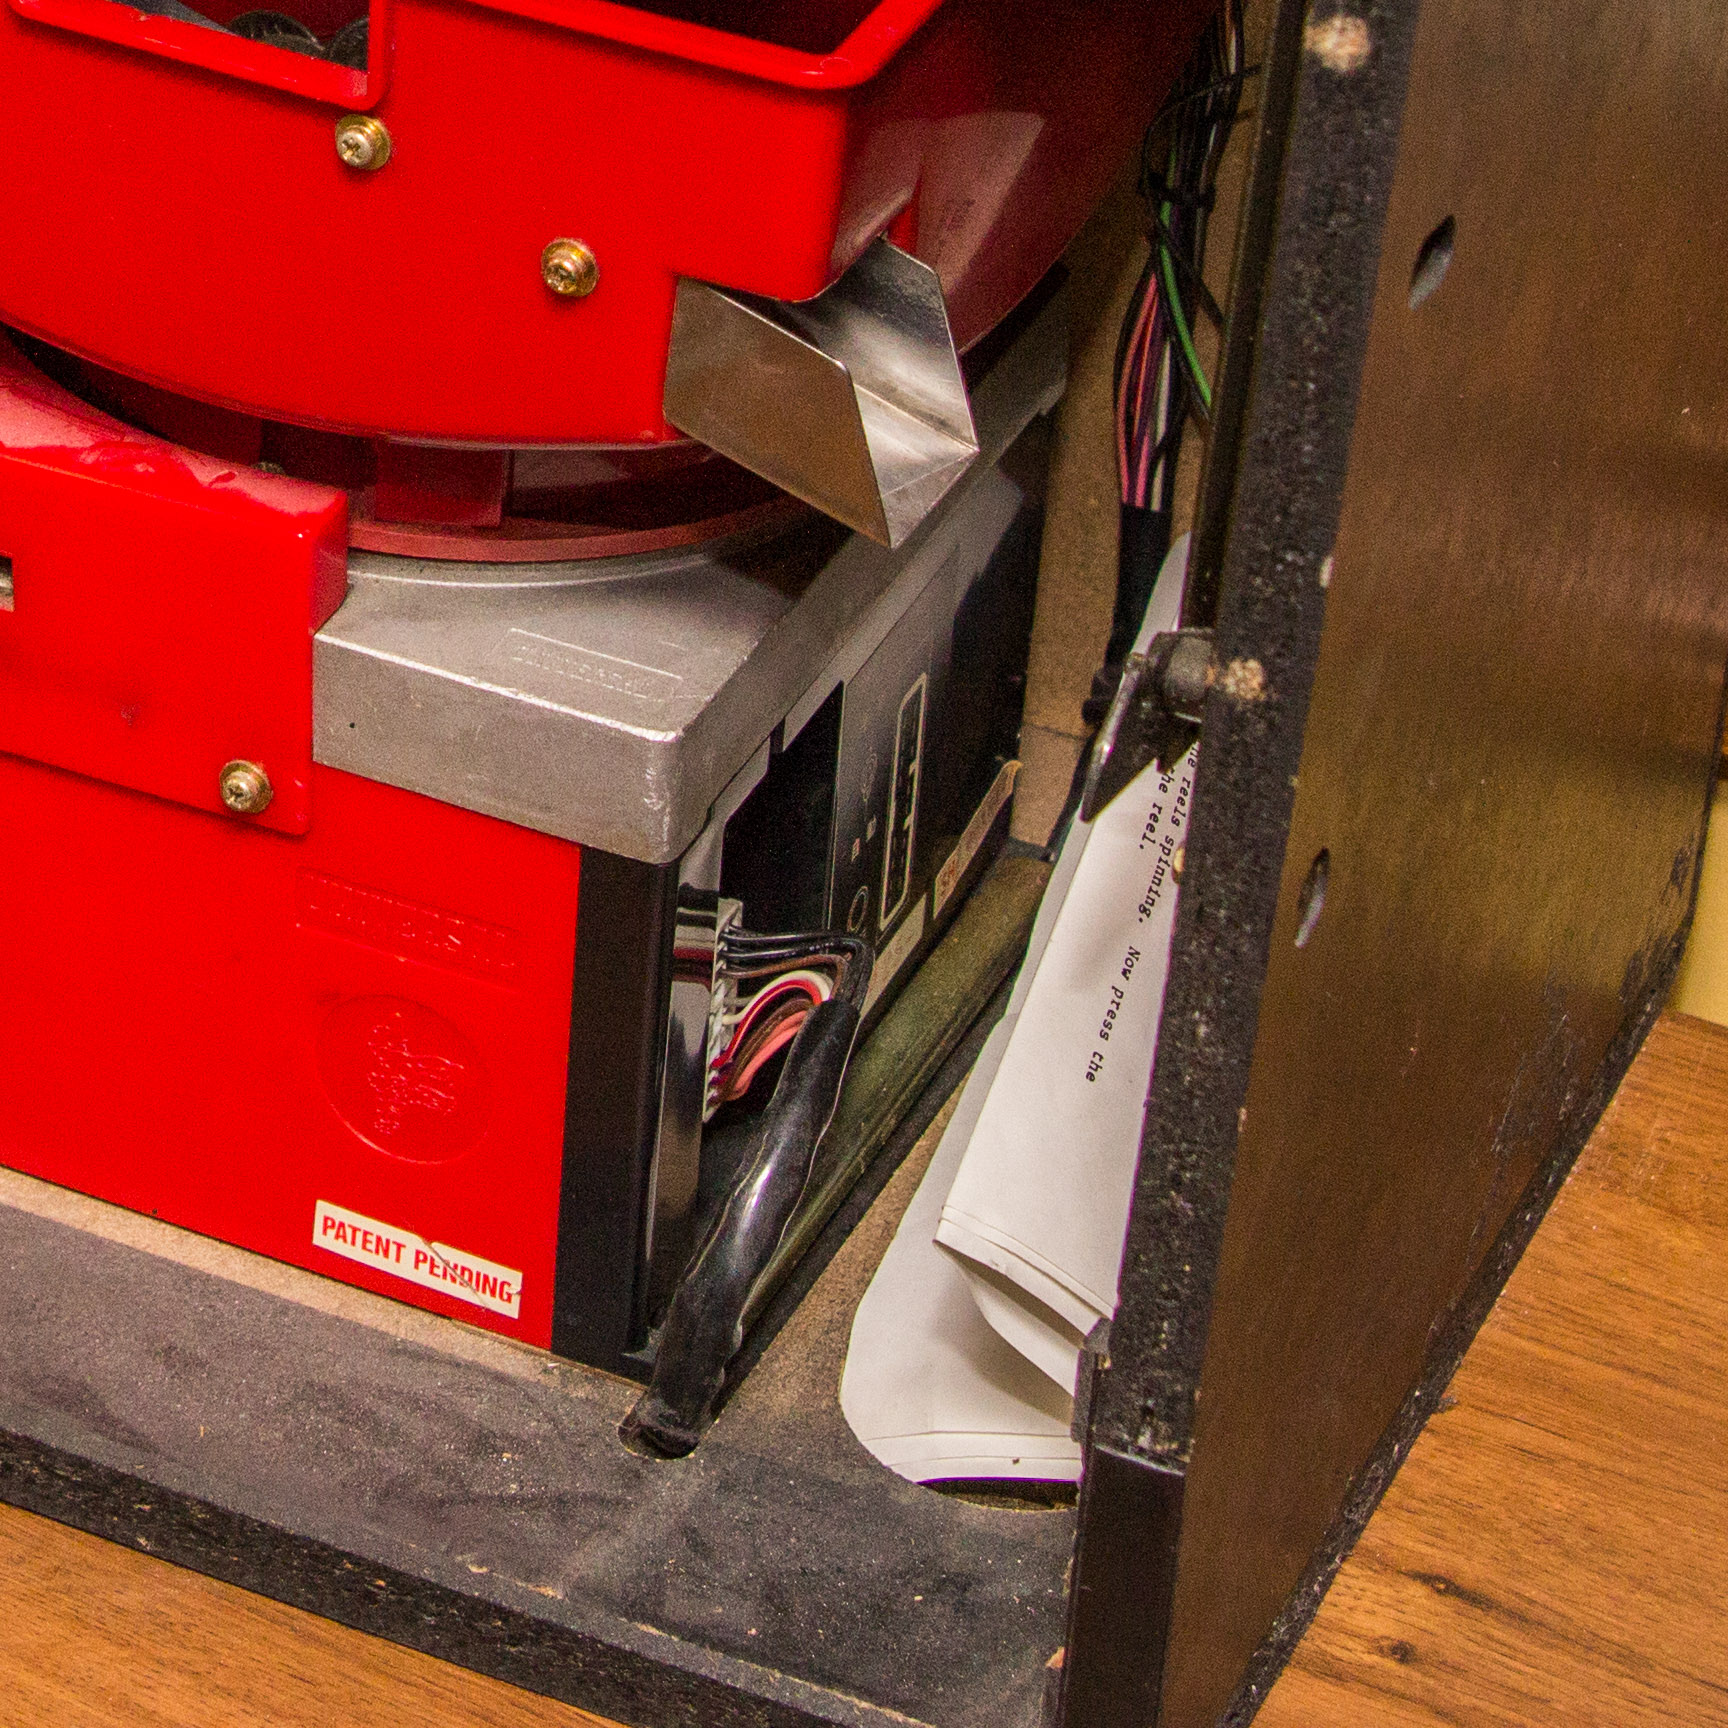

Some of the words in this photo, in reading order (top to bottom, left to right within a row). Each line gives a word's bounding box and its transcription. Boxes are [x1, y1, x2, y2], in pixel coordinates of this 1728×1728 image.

[1138, 802, 1163, 850] reel.
[1170, 776, 1191, 828] reels
[1137, 834, 1174, 924] spinning.
[1120, 945, 1142, 982] Now
[1099, 985, 1124, 1042] press
[1085, 1050, 1105, 1084] the
[321, 1214, 407, 1265] PATENT
[413, 1248, 513, 1305] PENDING
